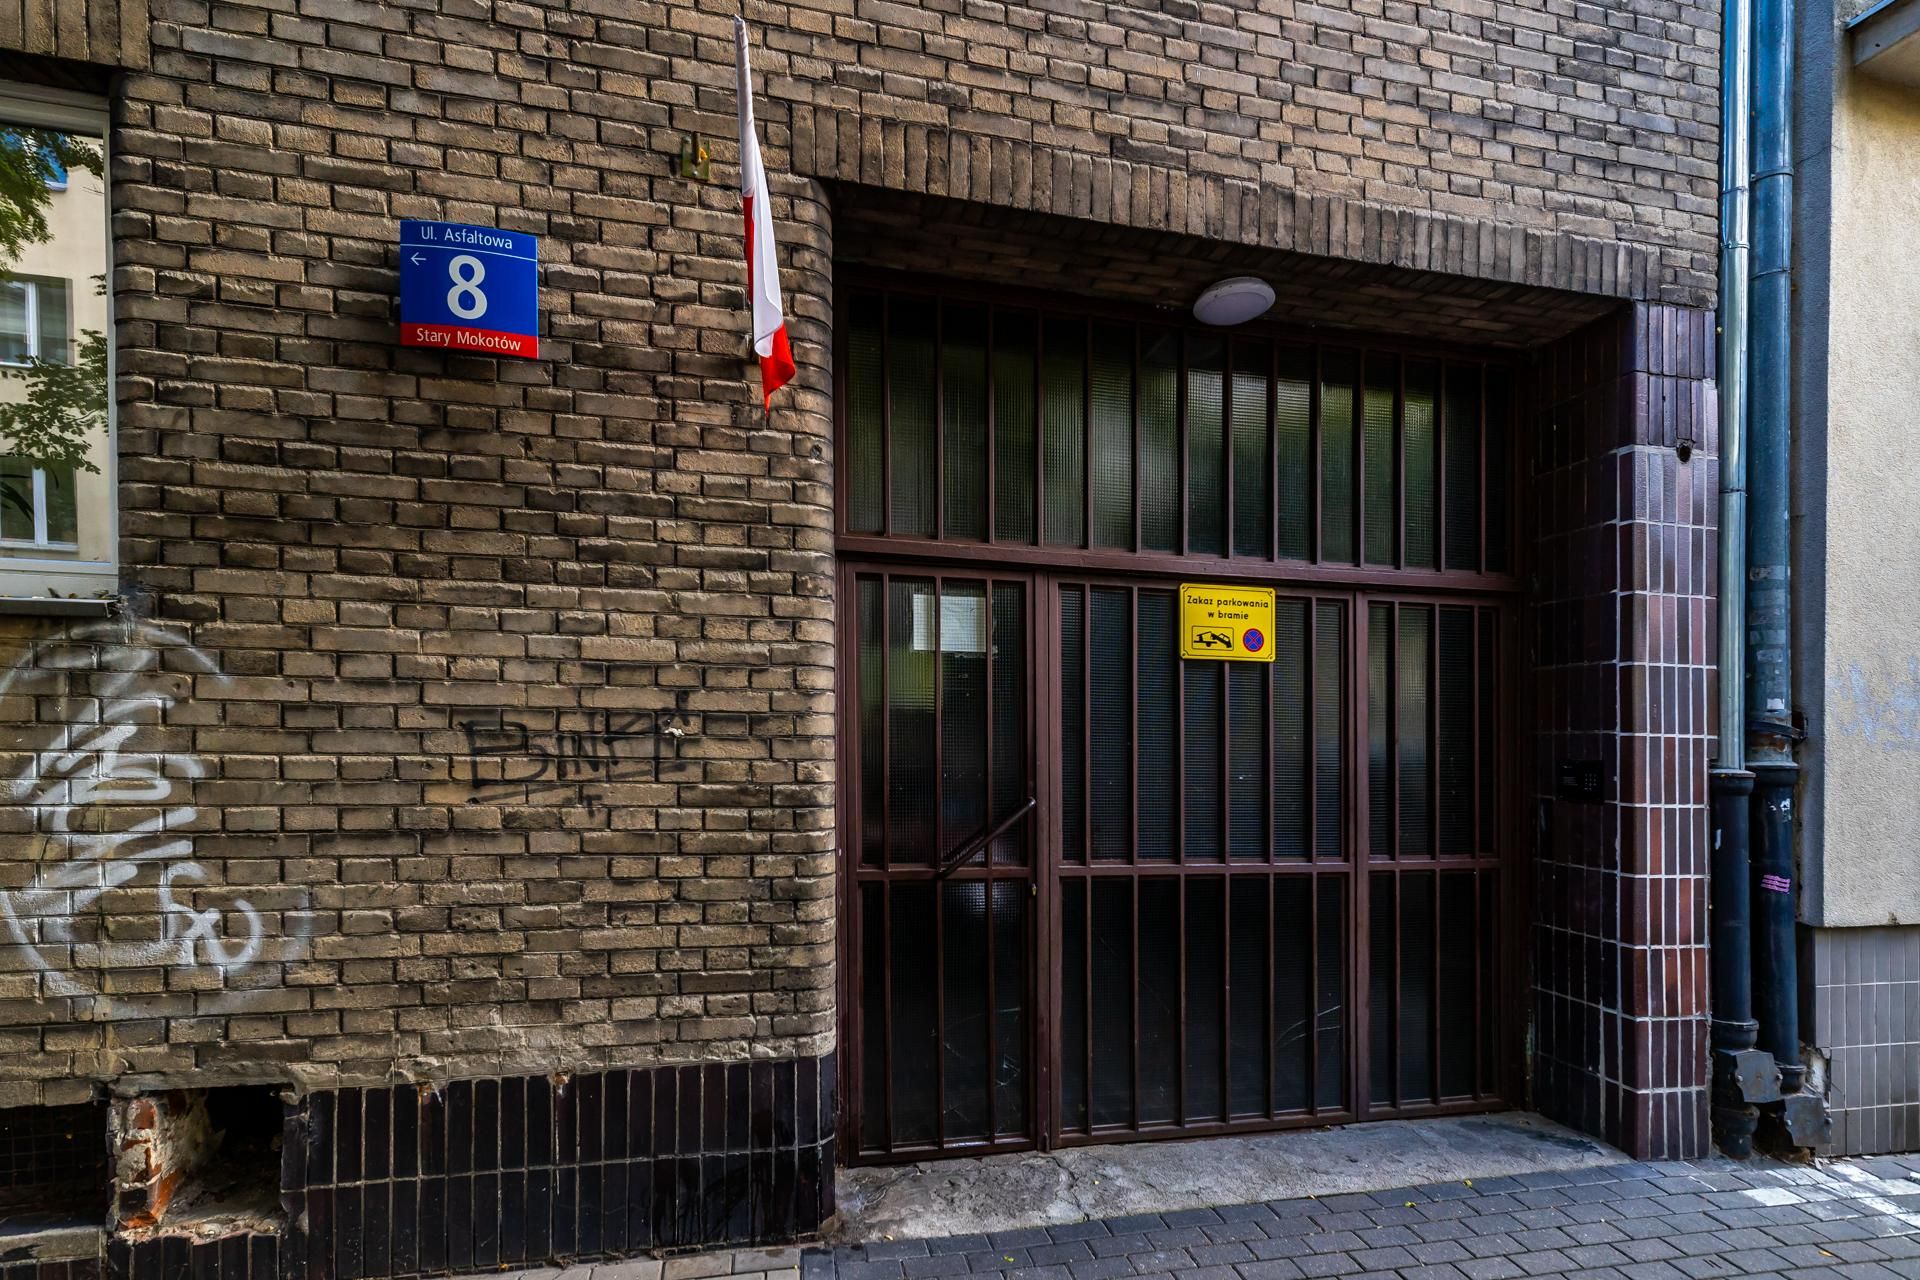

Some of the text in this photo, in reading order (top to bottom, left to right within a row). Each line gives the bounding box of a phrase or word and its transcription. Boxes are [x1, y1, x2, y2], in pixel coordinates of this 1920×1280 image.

[421, 226, 513, 249] Ul. Asfaltowa
[447, 255, 487, 320] 8
[416, 328, 521, 351] Stary Mokotów
[1187, 595, 1269, 608] Zakaz parkowania
[1218, 610, 1249, 620] bramie
